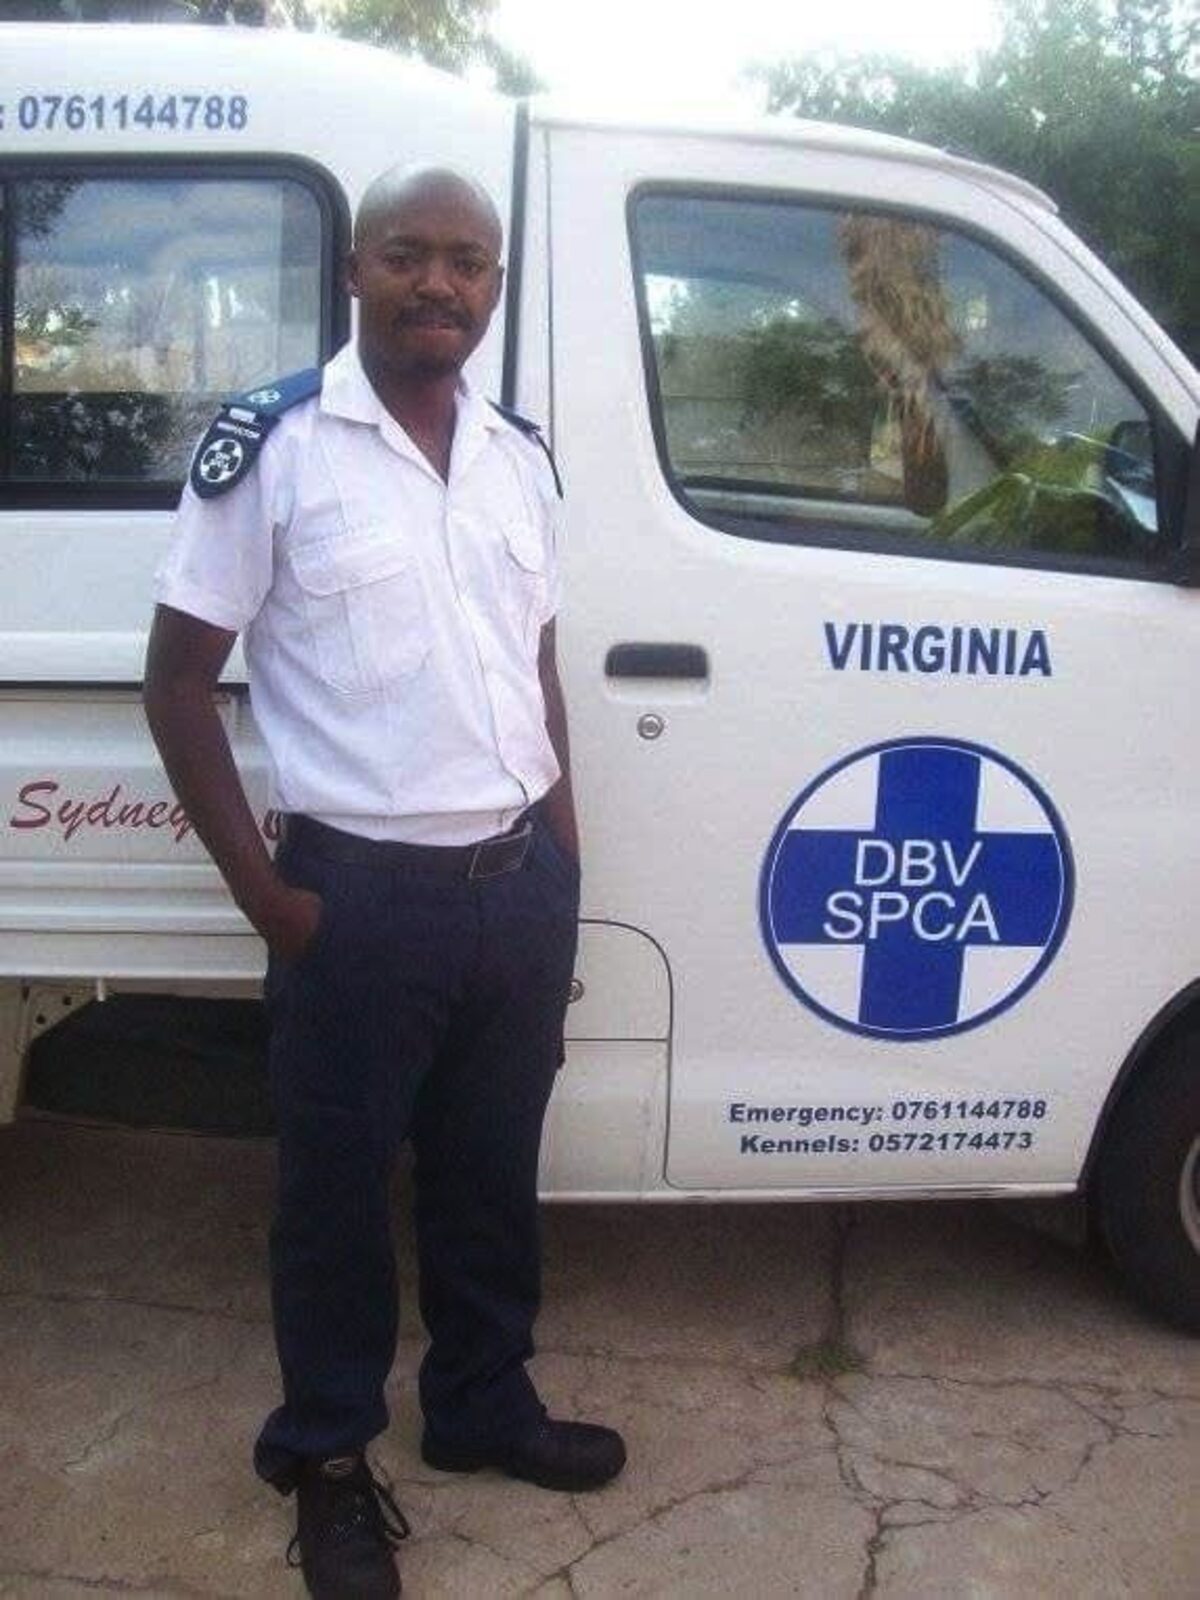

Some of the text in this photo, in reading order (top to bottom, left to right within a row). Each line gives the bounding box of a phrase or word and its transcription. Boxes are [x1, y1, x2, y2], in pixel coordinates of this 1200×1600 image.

[19, 95, 249, 130] 0761144788
[823, 622, 1052, 677] VIRGINIA
[853, 838, 982, 888] DBV
[823, 890, 1000, 942] SPCA
[729, 1100, 1048, 1126] Emergency: 0761144788
[739, 1132, 1033, 1154] Kennels: 0572174473
